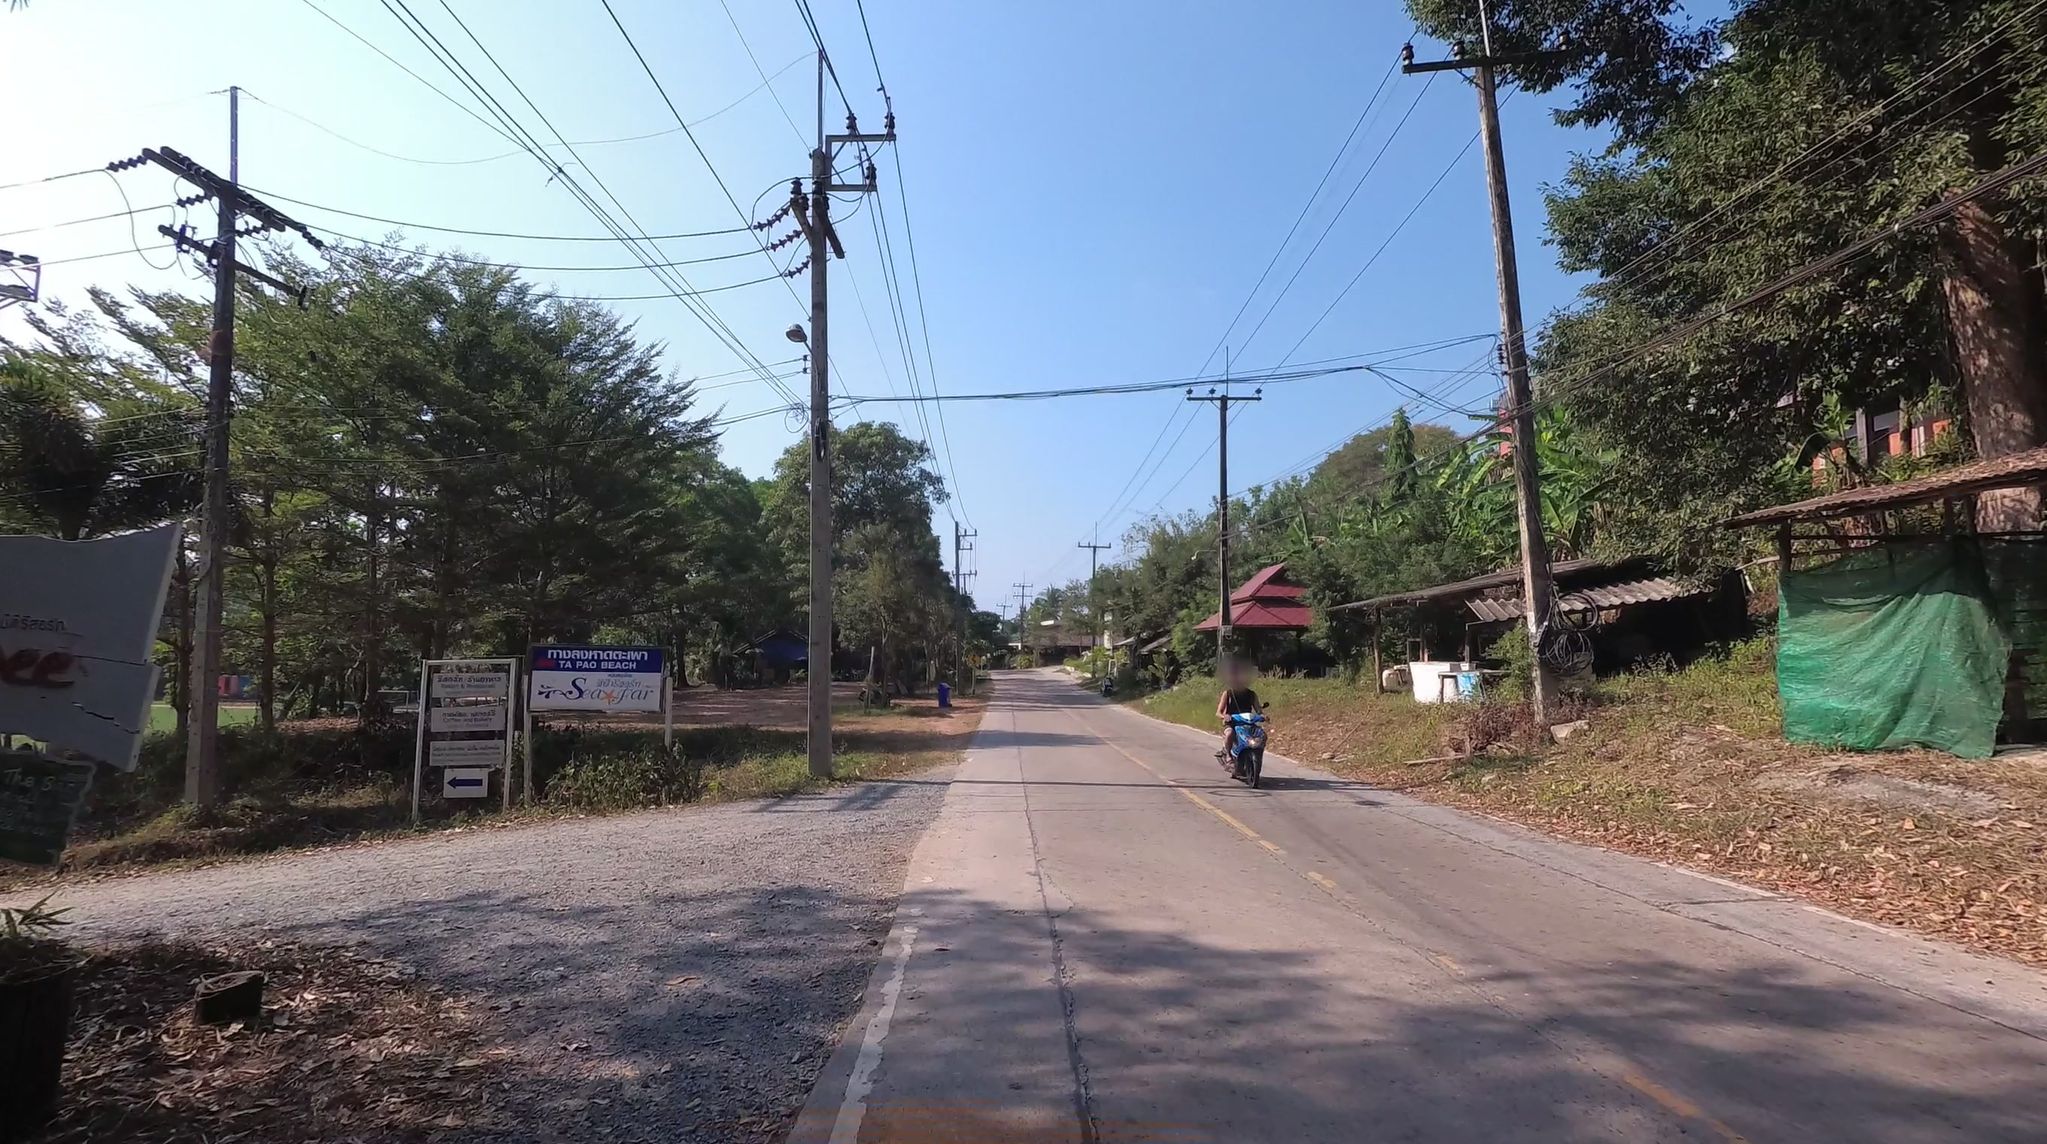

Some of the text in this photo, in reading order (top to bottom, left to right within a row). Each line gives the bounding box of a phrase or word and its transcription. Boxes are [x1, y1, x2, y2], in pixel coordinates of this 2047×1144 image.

[558, 660, 637, 670] TA PAO BEACH
